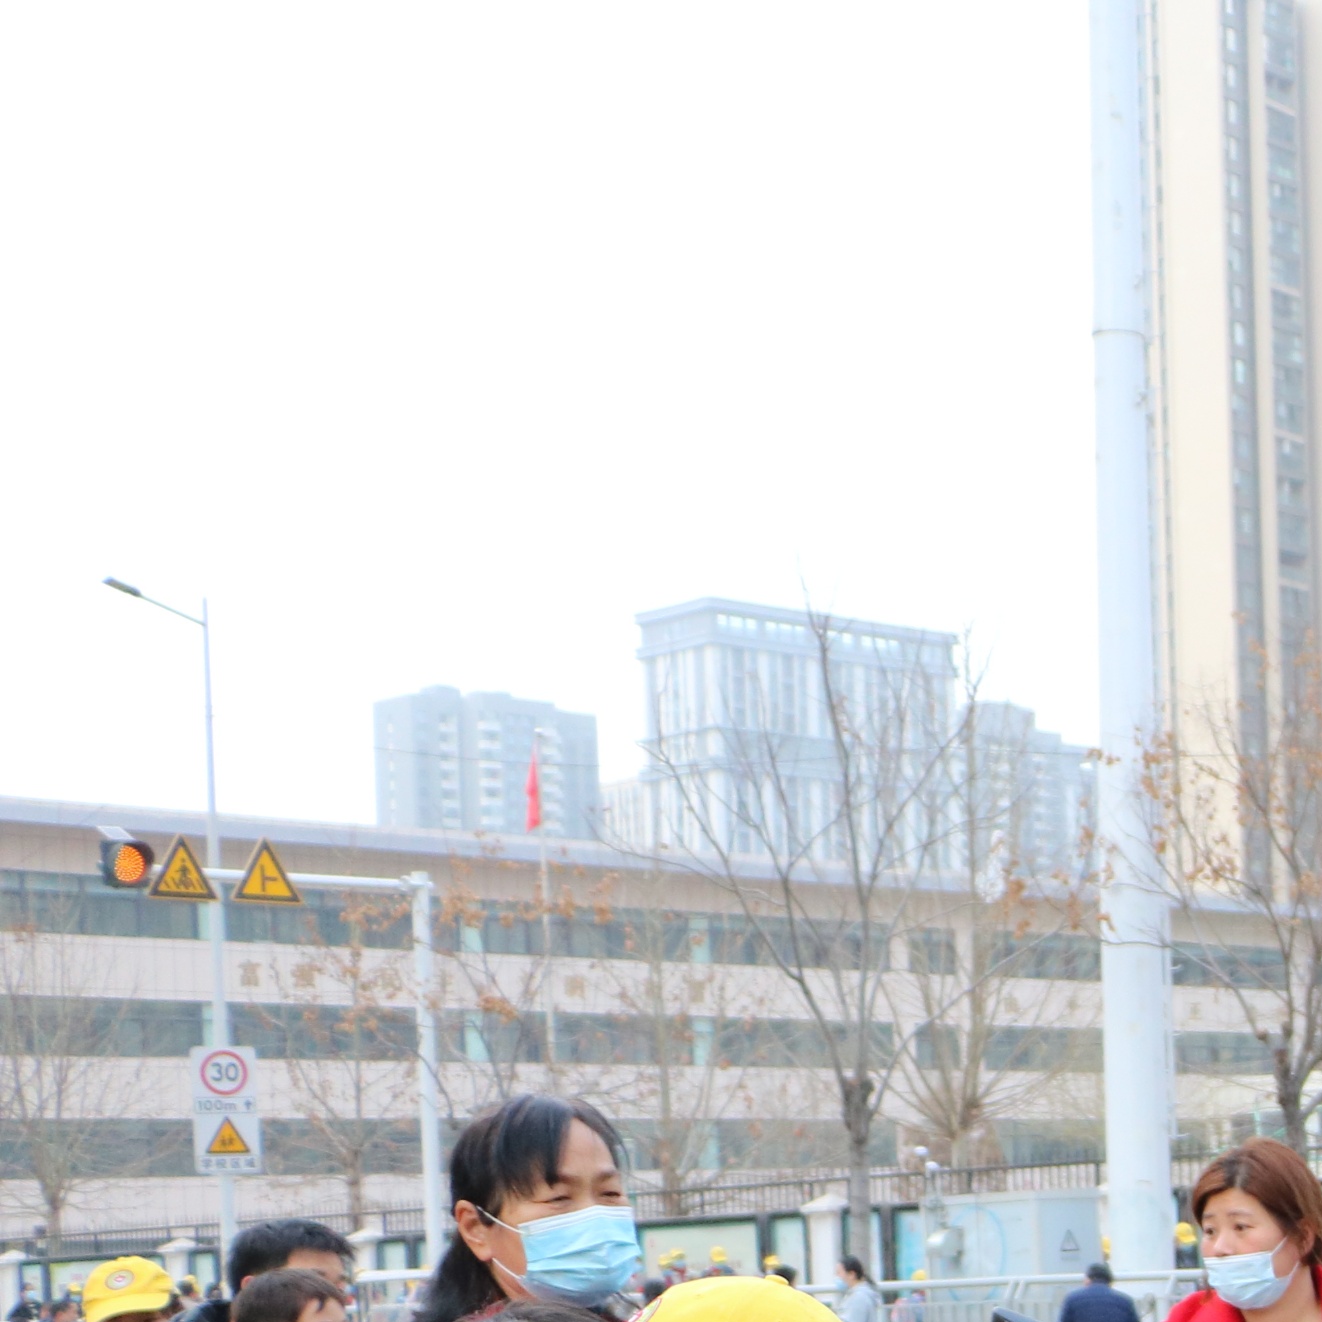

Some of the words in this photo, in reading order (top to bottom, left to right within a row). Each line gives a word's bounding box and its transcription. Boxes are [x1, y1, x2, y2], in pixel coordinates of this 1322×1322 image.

[210, 1062, 239, 1082] 30
[197, 1100, 237, 1111] 100m
[201, 1157, 256, 1170] 学校区域
